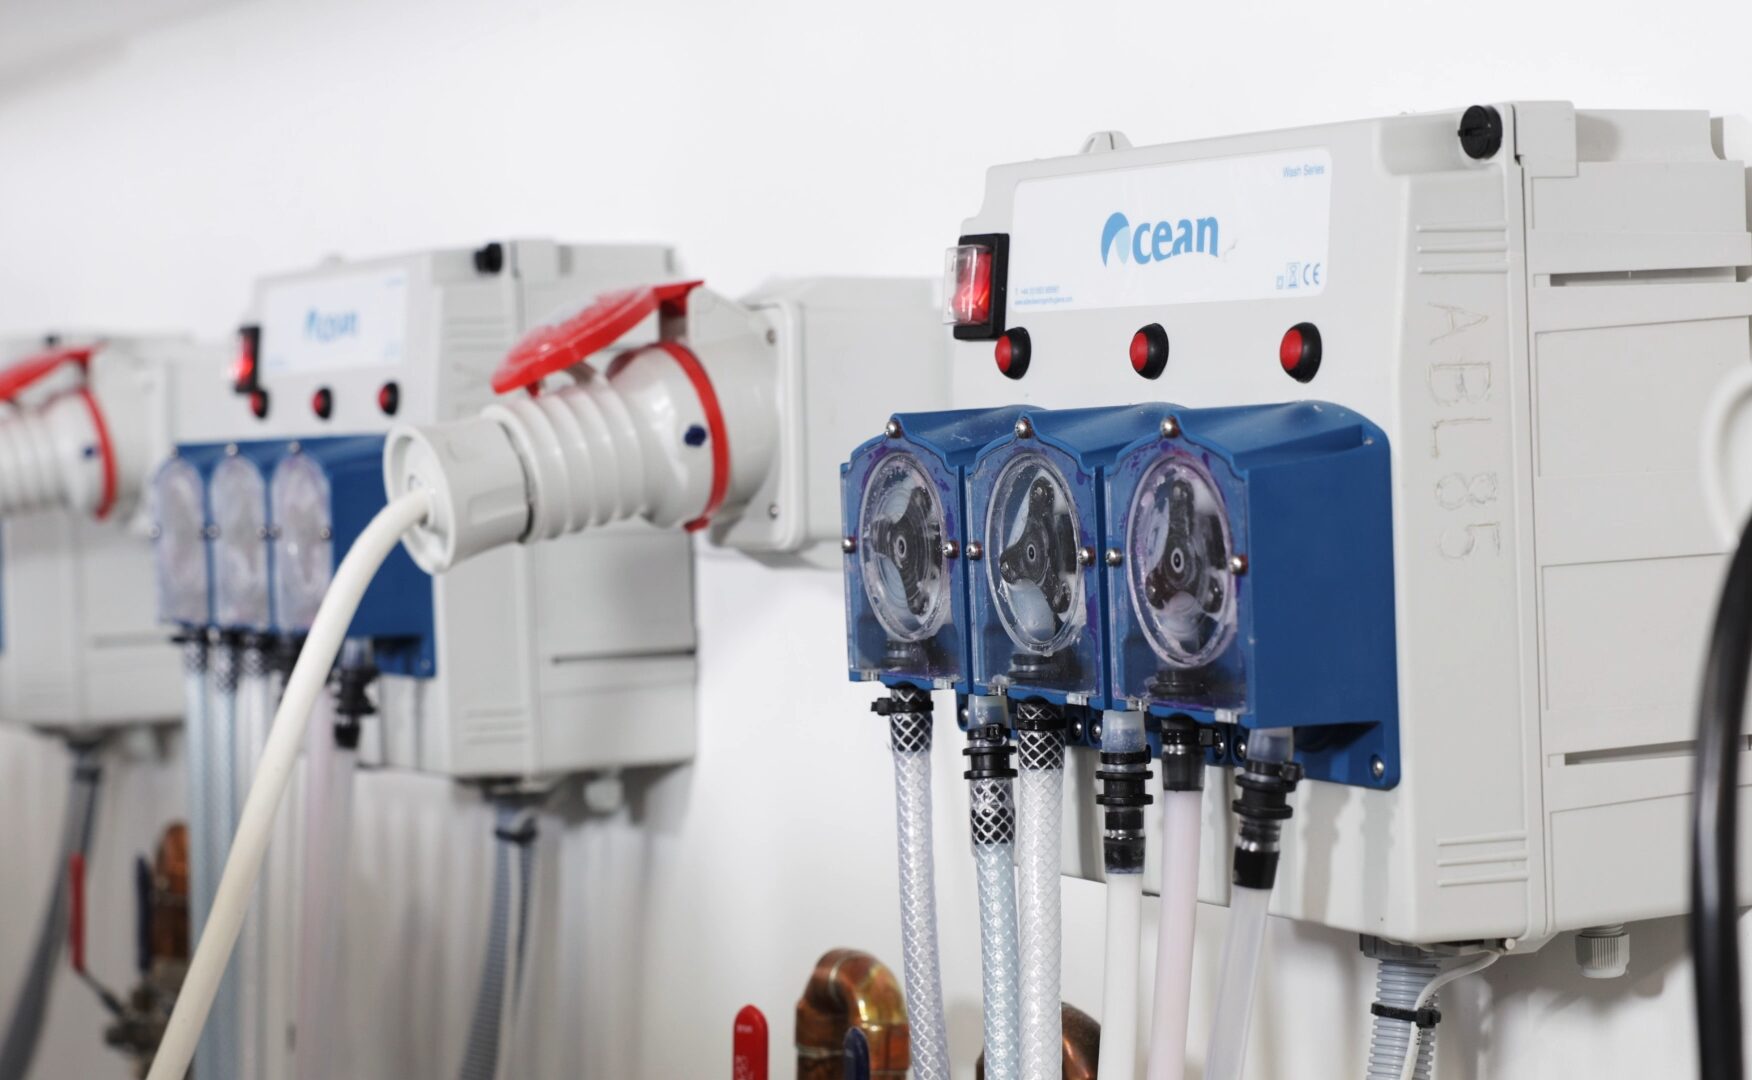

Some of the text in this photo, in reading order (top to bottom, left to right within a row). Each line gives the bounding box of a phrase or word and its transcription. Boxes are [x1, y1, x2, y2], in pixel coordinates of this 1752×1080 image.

[1283, 163, 1325, 178] Wash Series
[1101, 211, 1219, 267] Ocean
